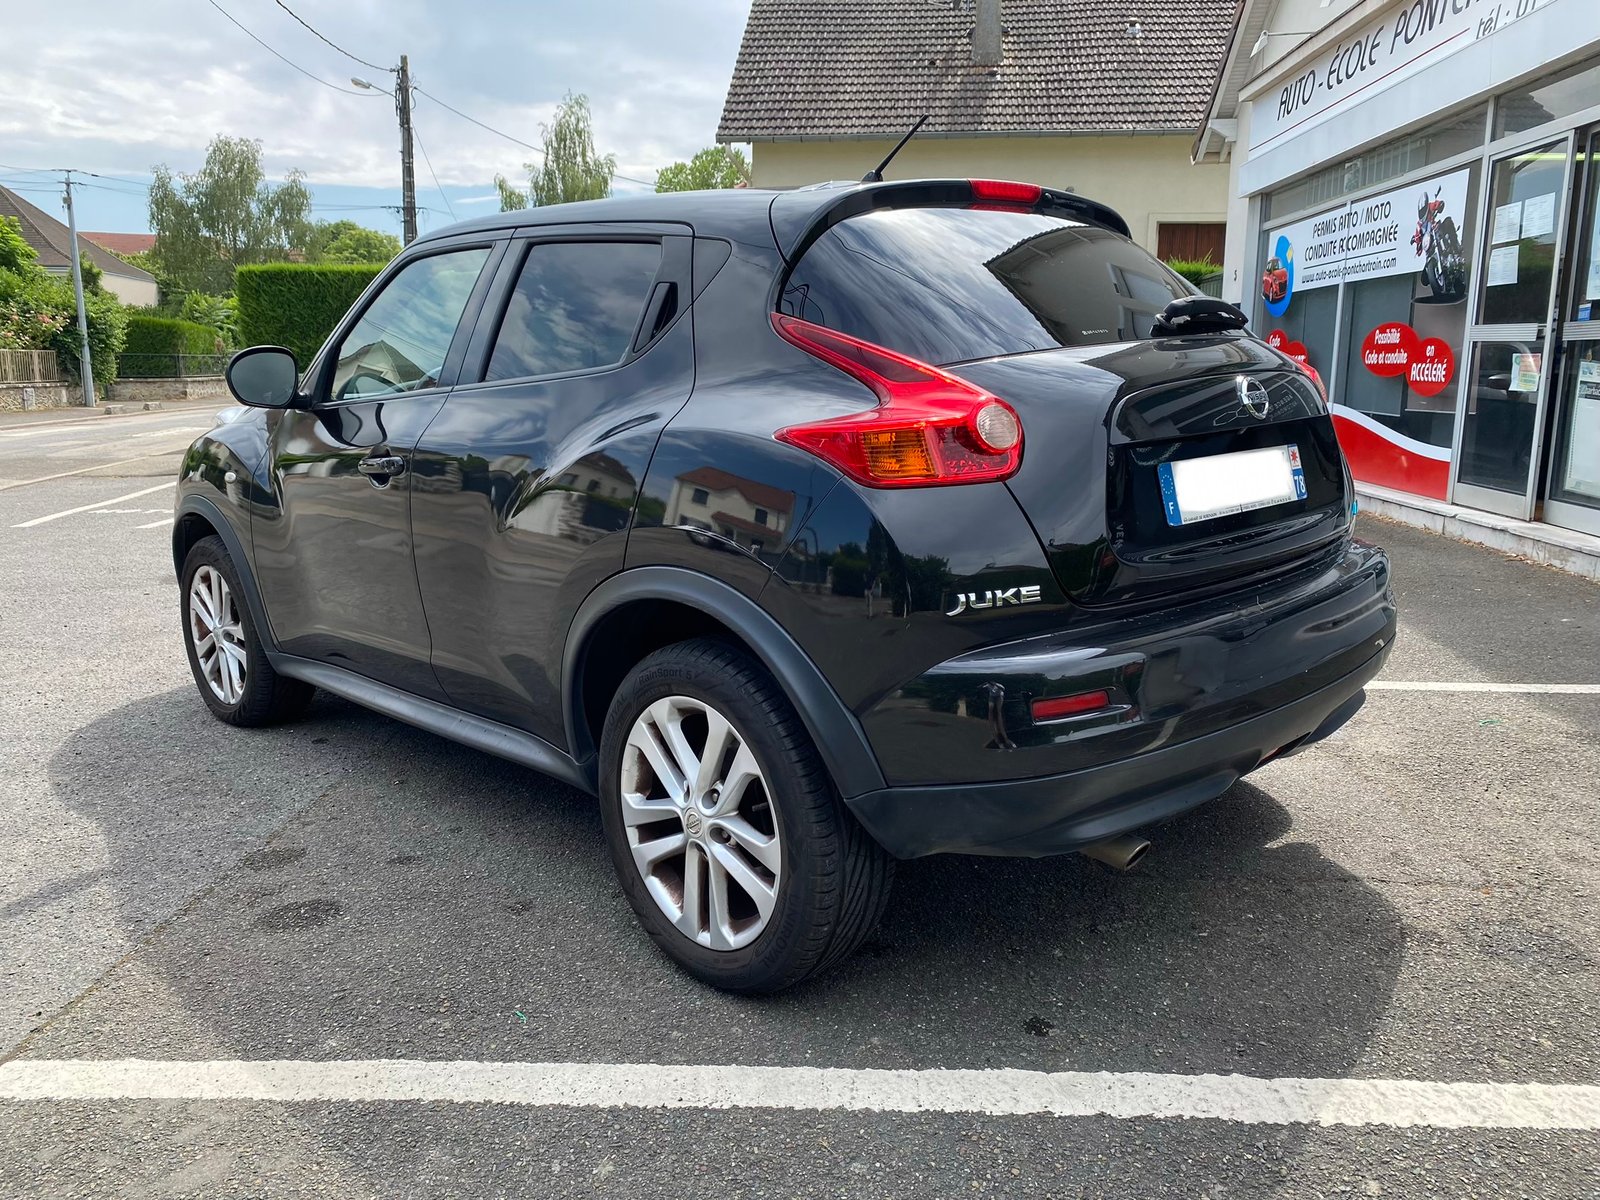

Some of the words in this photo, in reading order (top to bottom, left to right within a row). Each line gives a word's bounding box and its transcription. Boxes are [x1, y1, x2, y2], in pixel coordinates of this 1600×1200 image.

[1388, 0, 1480, 55] PON
[1312, 217, 1338, 239] PERMIS
[1364, 200, 1392, 225] MOTO
[1304, 239, 1338, 262] CONDUITE
[1338, 220, 1399, 254] ACCOMPAGNÉE
[1374, 327, 1401, 345] Possibilité
[1364, 349, 1378, 365] Code
[1378, 350, 1385, 365] et
[1384, 348, 1408, 365] conduite
[1425, 345, 1435, 357] en
[1410, 358, 1448, 382] ACCÉLÉRÉ
[1292, 473, 1306, 495] 78
[1168, 501, 1174, 515] F
[945, 585, 1042, 617] JUKE
[637, 667, 683, 687] RainSport
